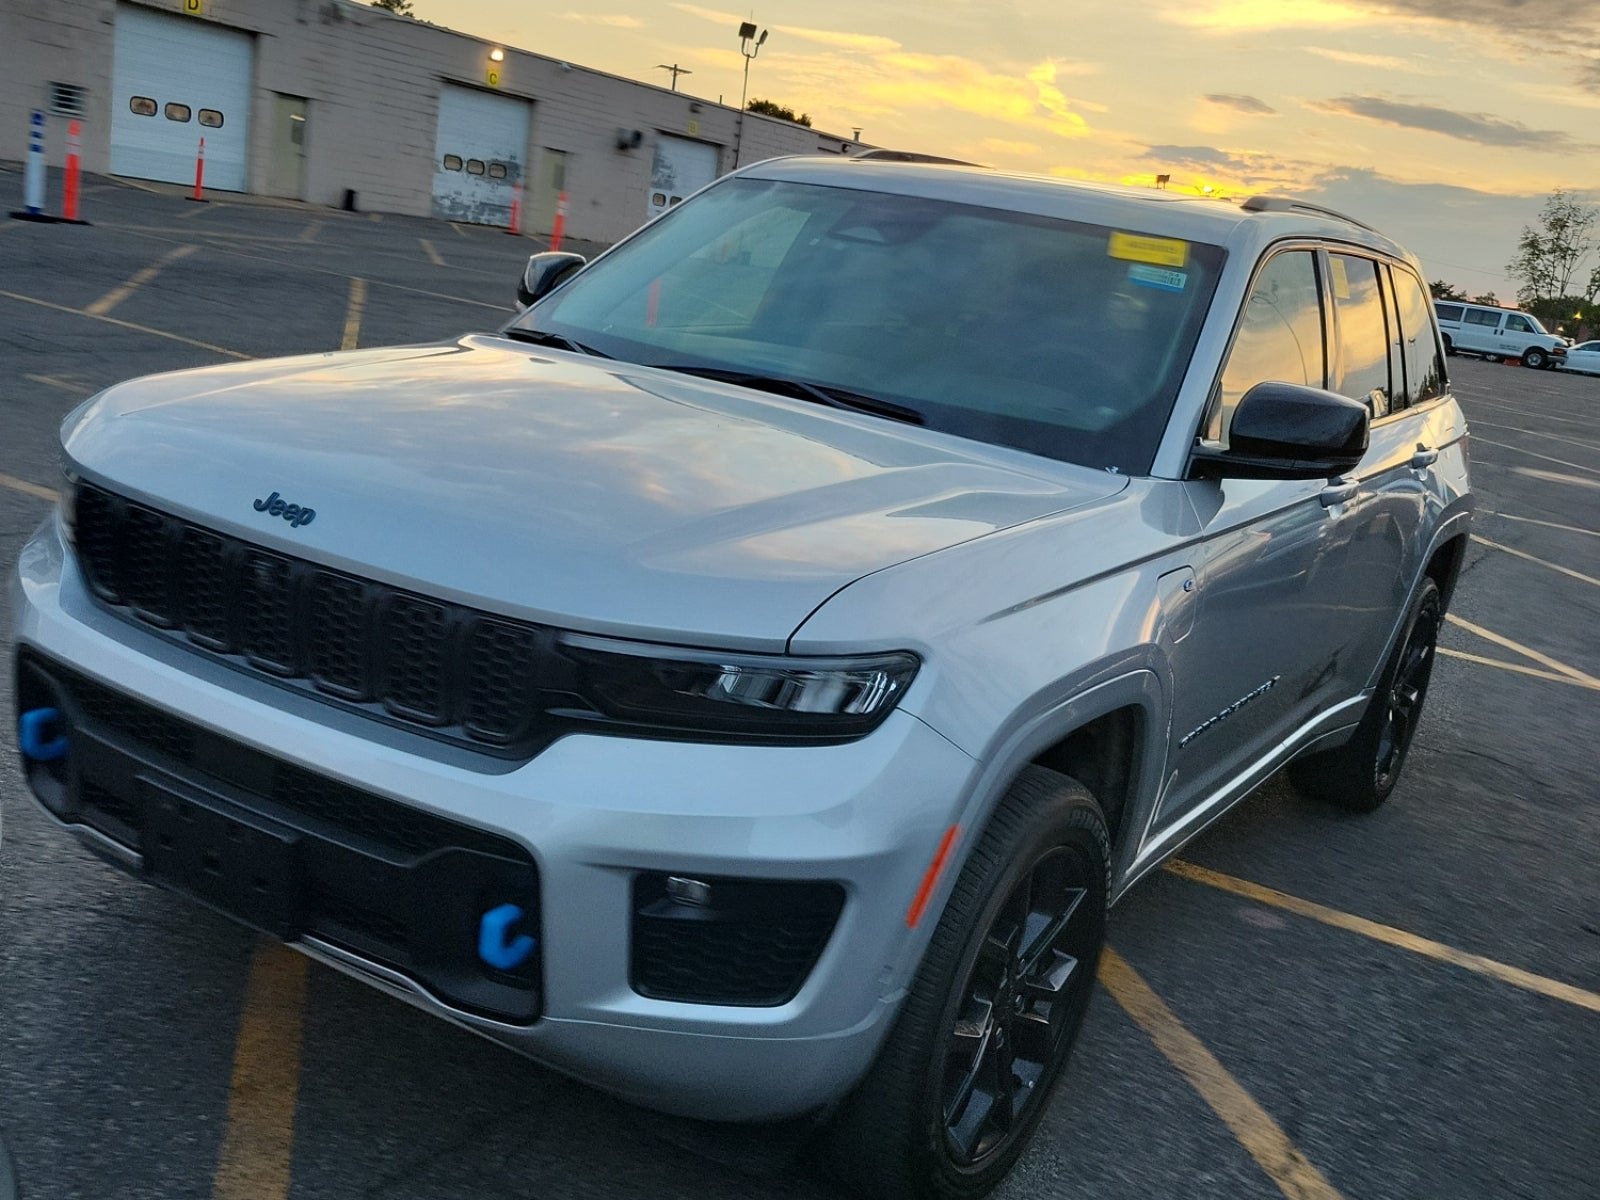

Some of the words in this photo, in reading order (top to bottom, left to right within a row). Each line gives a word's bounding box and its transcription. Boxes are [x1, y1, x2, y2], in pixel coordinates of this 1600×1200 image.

[188, 0, 199, 10] D
[490, 73, 497, 85] C
[253, 491, 317, 529] Jeep
